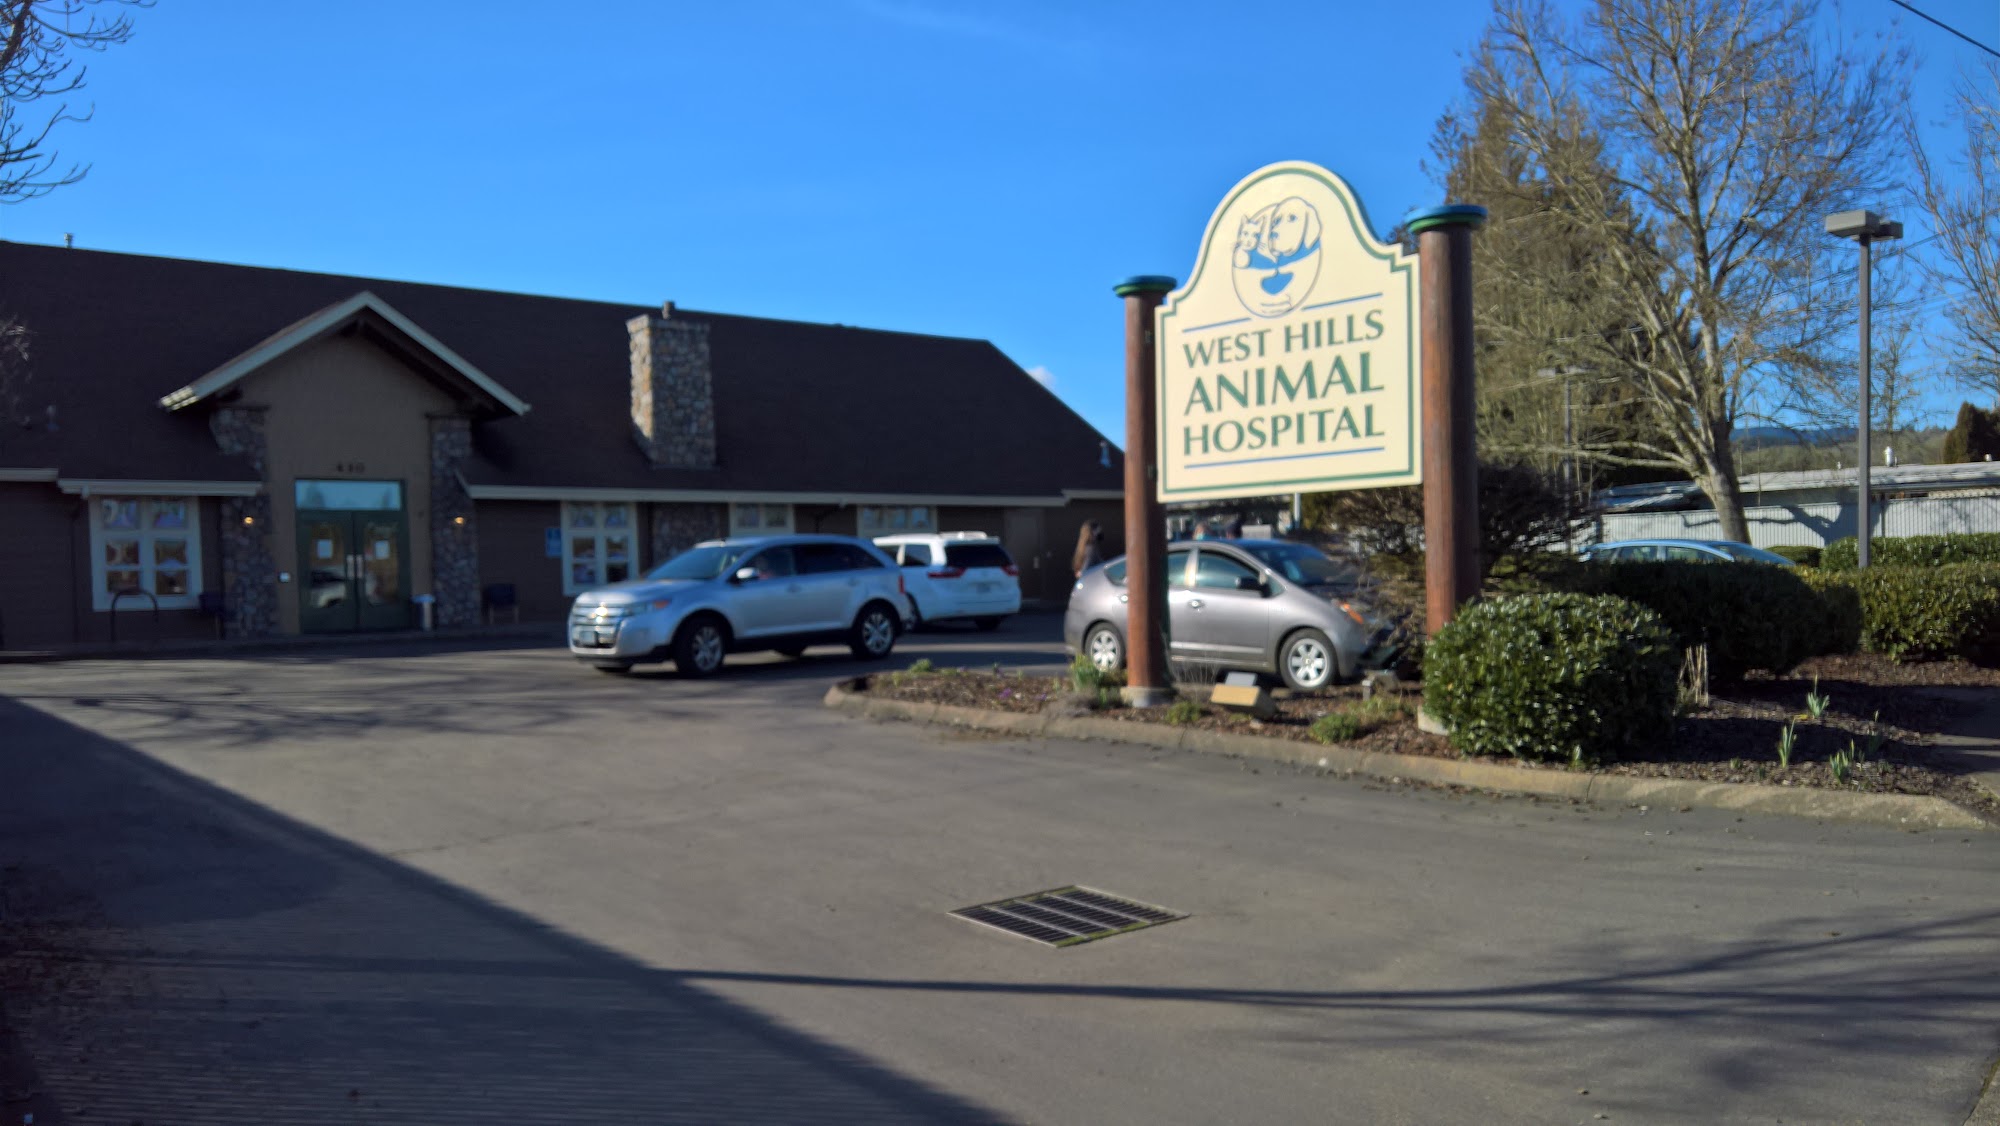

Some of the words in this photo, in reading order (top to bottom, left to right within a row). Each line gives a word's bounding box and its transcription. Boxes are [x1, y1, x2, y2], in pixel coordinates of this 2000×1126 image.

[1183, 329, 1271, 368] WEST
[1283, 309, 1385, 352] HILLS
[1184, 352, 1385, 416] ANIMAL
[1184, 404, 1385, 456] HOSPITAL
